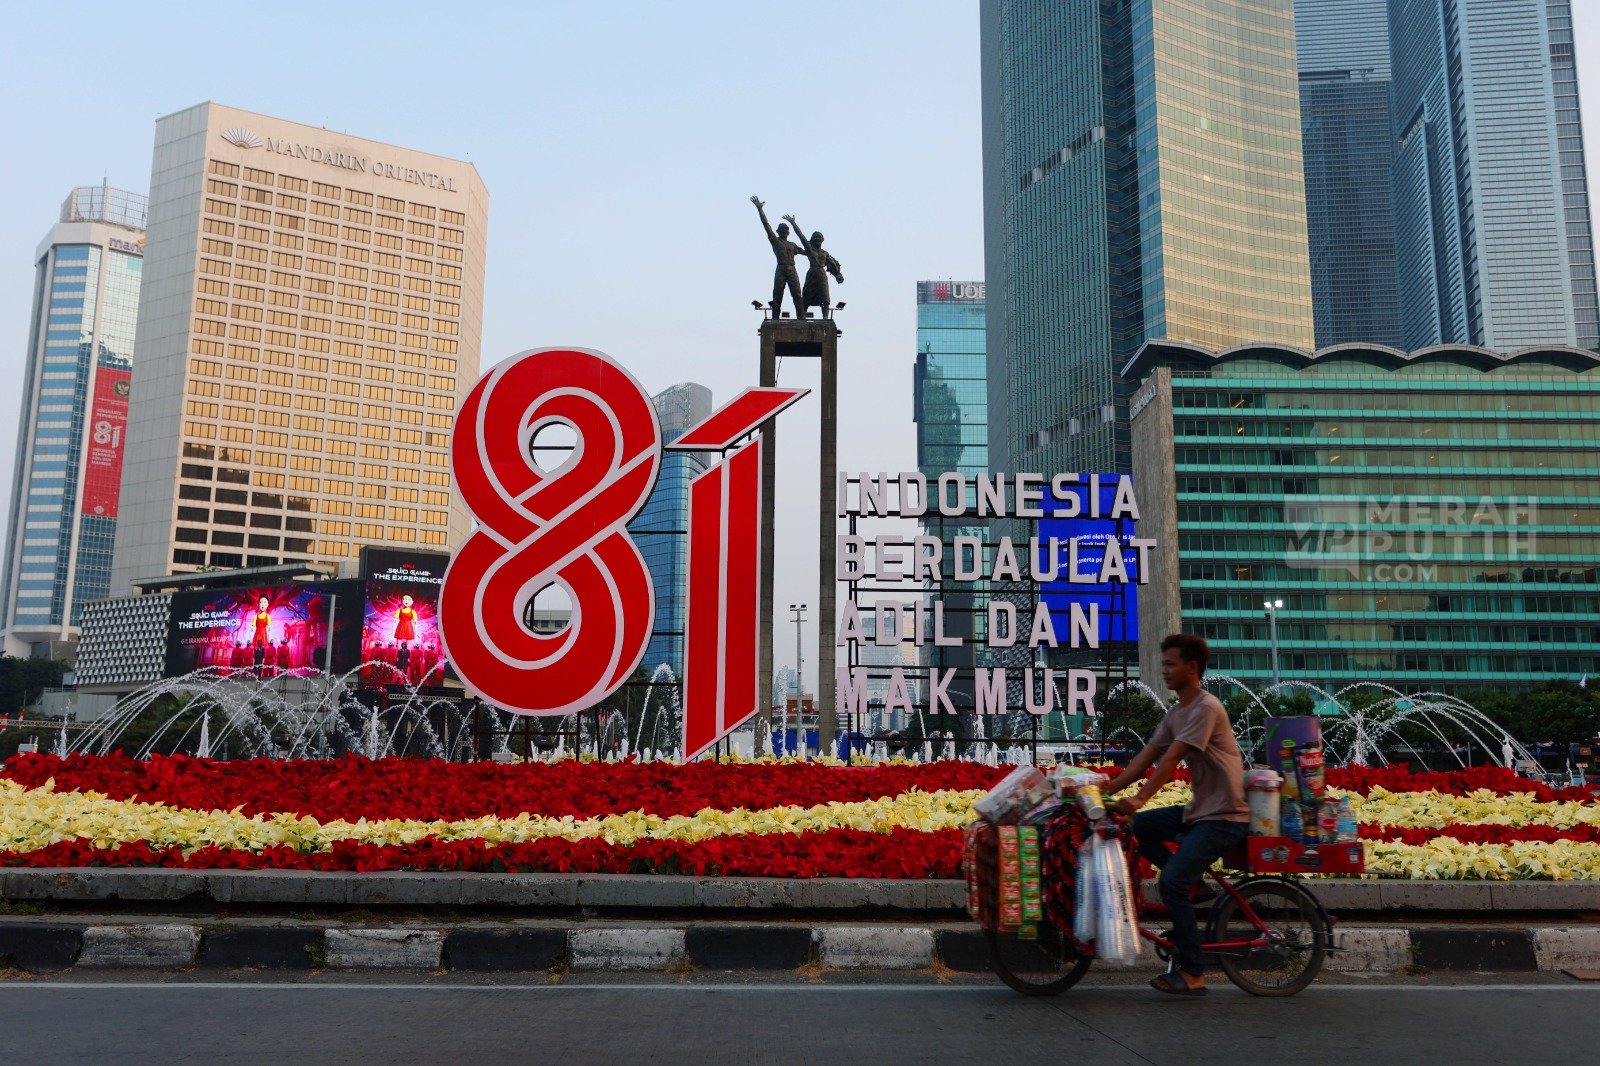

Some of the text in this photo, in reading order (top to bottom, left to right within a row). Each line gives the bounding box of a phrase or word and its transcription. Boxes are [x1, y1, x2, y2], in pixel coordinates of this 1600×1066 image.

[266, 137, 458, 193] MANDARIN ORIENTAL
[94, 421, 122, 448] 81
[837, 471, 1140, 521] INDONESIA
[392, 575, 443, 584] EXPERIENCE
[438, 346, 811, 765] 81
[836, 535, 1157, 585] BERDAULAT
[194, 619, 241, 628] EXPERIENCE
[837, 600, 1100, 649] ADIL DAN
[836, 667, 1098, 717] MAKMUR
